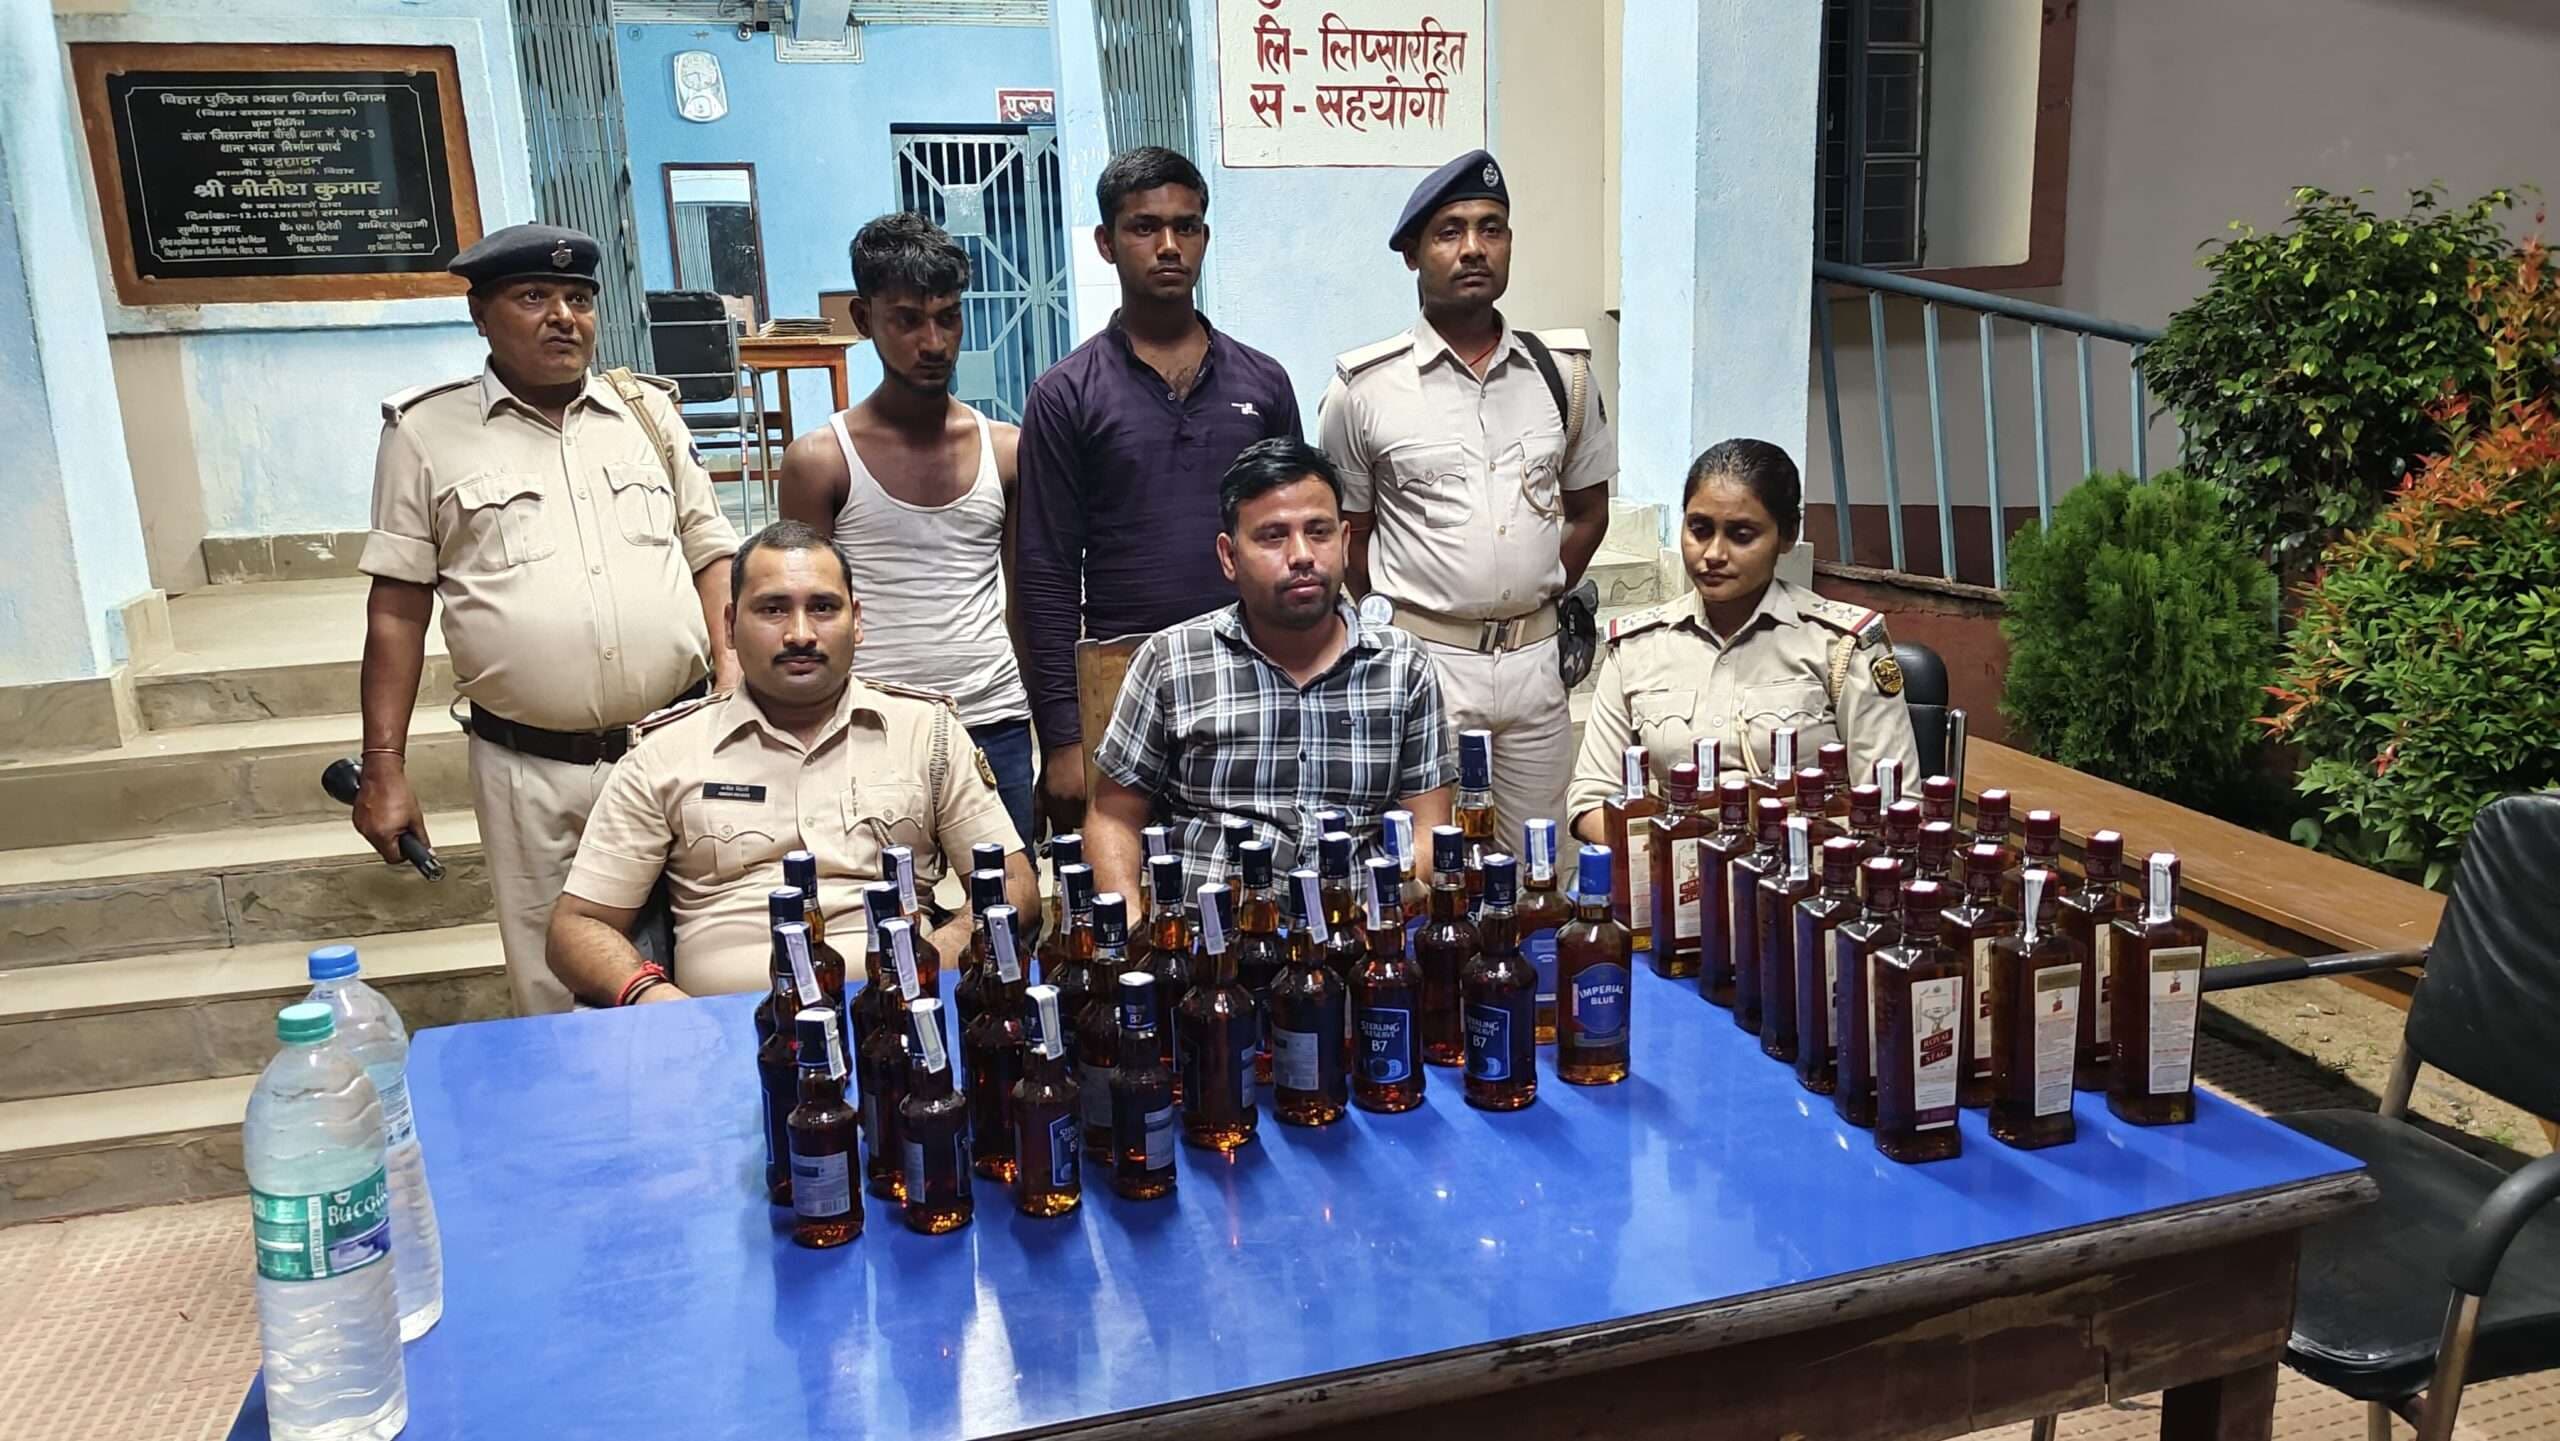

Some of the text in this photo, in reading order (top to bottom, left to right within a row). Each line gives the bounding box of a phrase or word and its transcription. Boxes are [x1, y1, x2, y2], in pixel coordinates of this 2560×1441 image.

[1318, 12, 1467, 76] लिप्सारहित
[160, 91, 386, 107] बिहार पुलिस भवन निर्माण निगम
[1316, 72, 1449, 132] सहयोगी
[220, 139, 342, 153] थाना भवन निर्माण कार्य
[240, 158, 259, 167] का
[193, 178, 383, 201] श्री नीतीश कुमार
[211, 224, 241, 236] कुमार
[1579, 984, 1624, 999] IMPERIAL
[1590, 995, 1616, 1005] BLUE
[1371, 1039, 1388, 1052] B7
